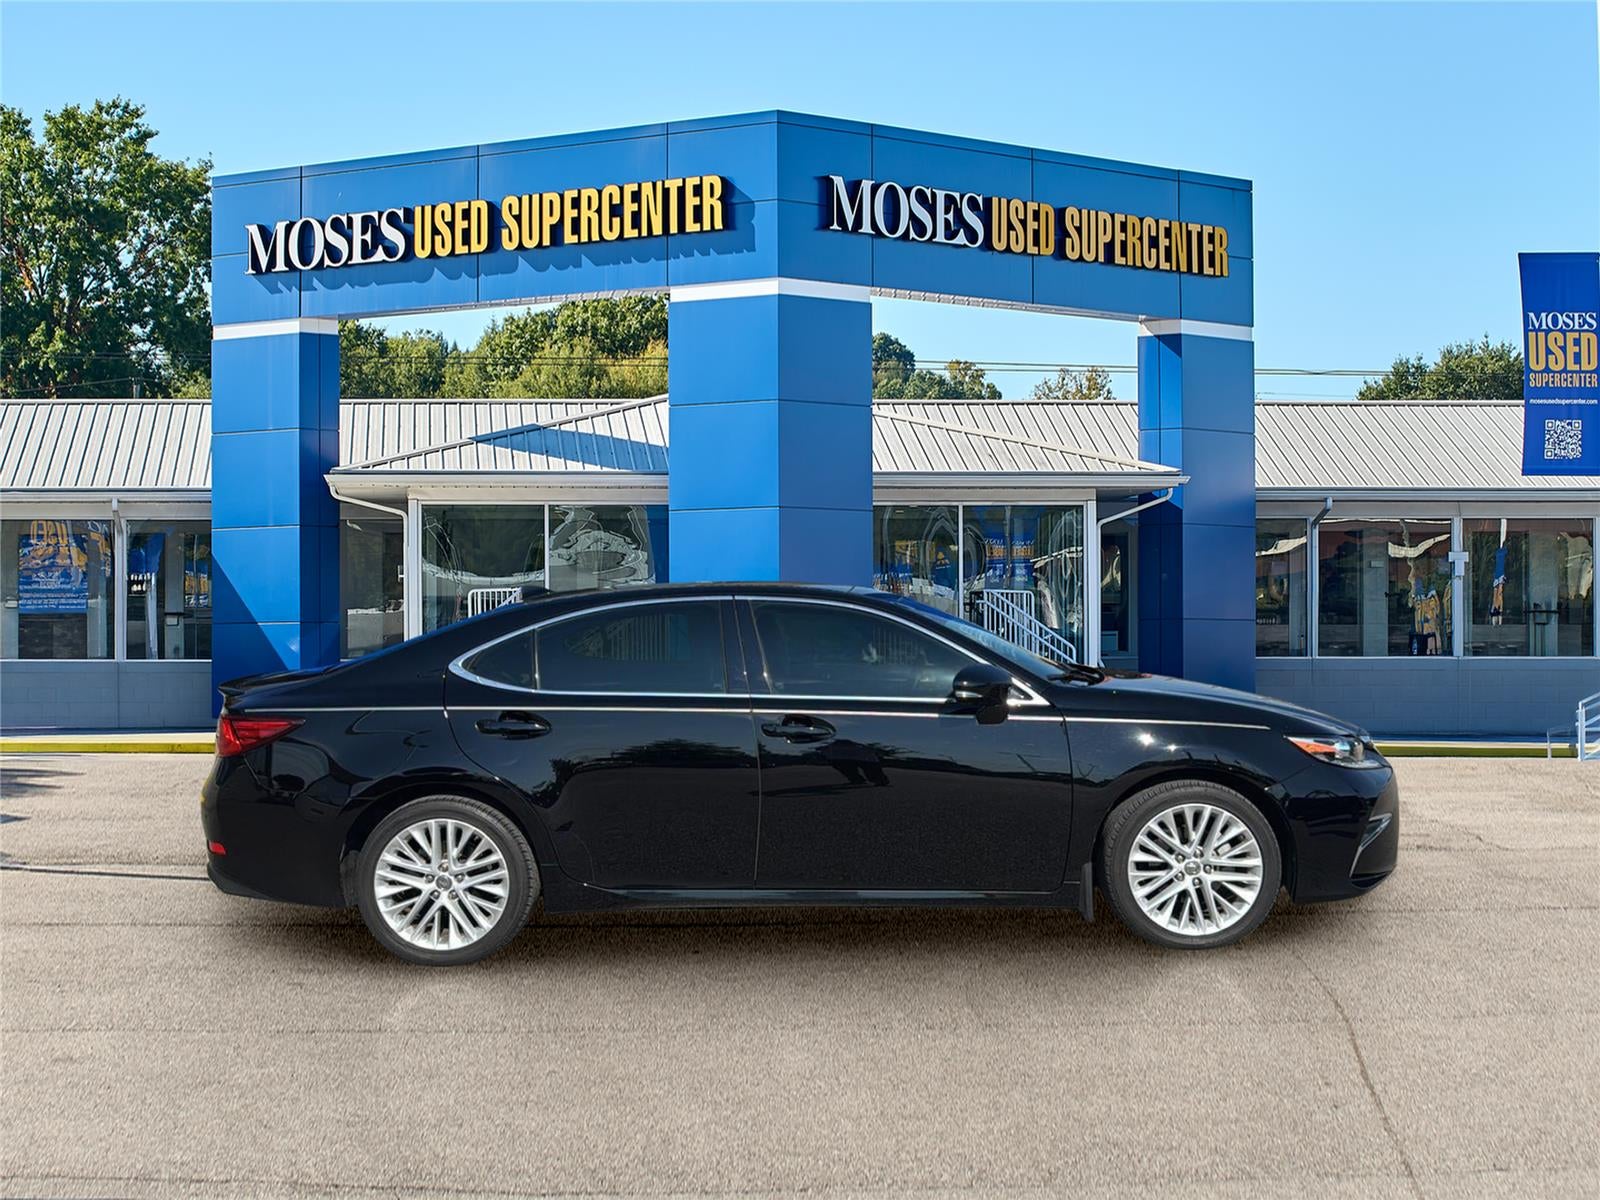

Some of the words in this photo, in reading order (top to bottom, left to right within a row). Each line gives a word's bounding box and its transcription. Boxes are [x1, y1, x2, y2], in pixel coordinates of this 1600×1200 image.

[245, 207, 407, 275] MOSES
[413, 199, 489, 259] USED
[501, 175, 724, 250] SUPERCENTER
[829, 174, 985, 248] MOSES
[991, 196, 1055, 255] USED
[1064, 206, 1230, 277] SUPERCENTER
[1528, 312, 1597, 330] MOSES
[1528, 332, 1598, 371] USED
[1529, 373, 1598, 388] SUPERCENTER
